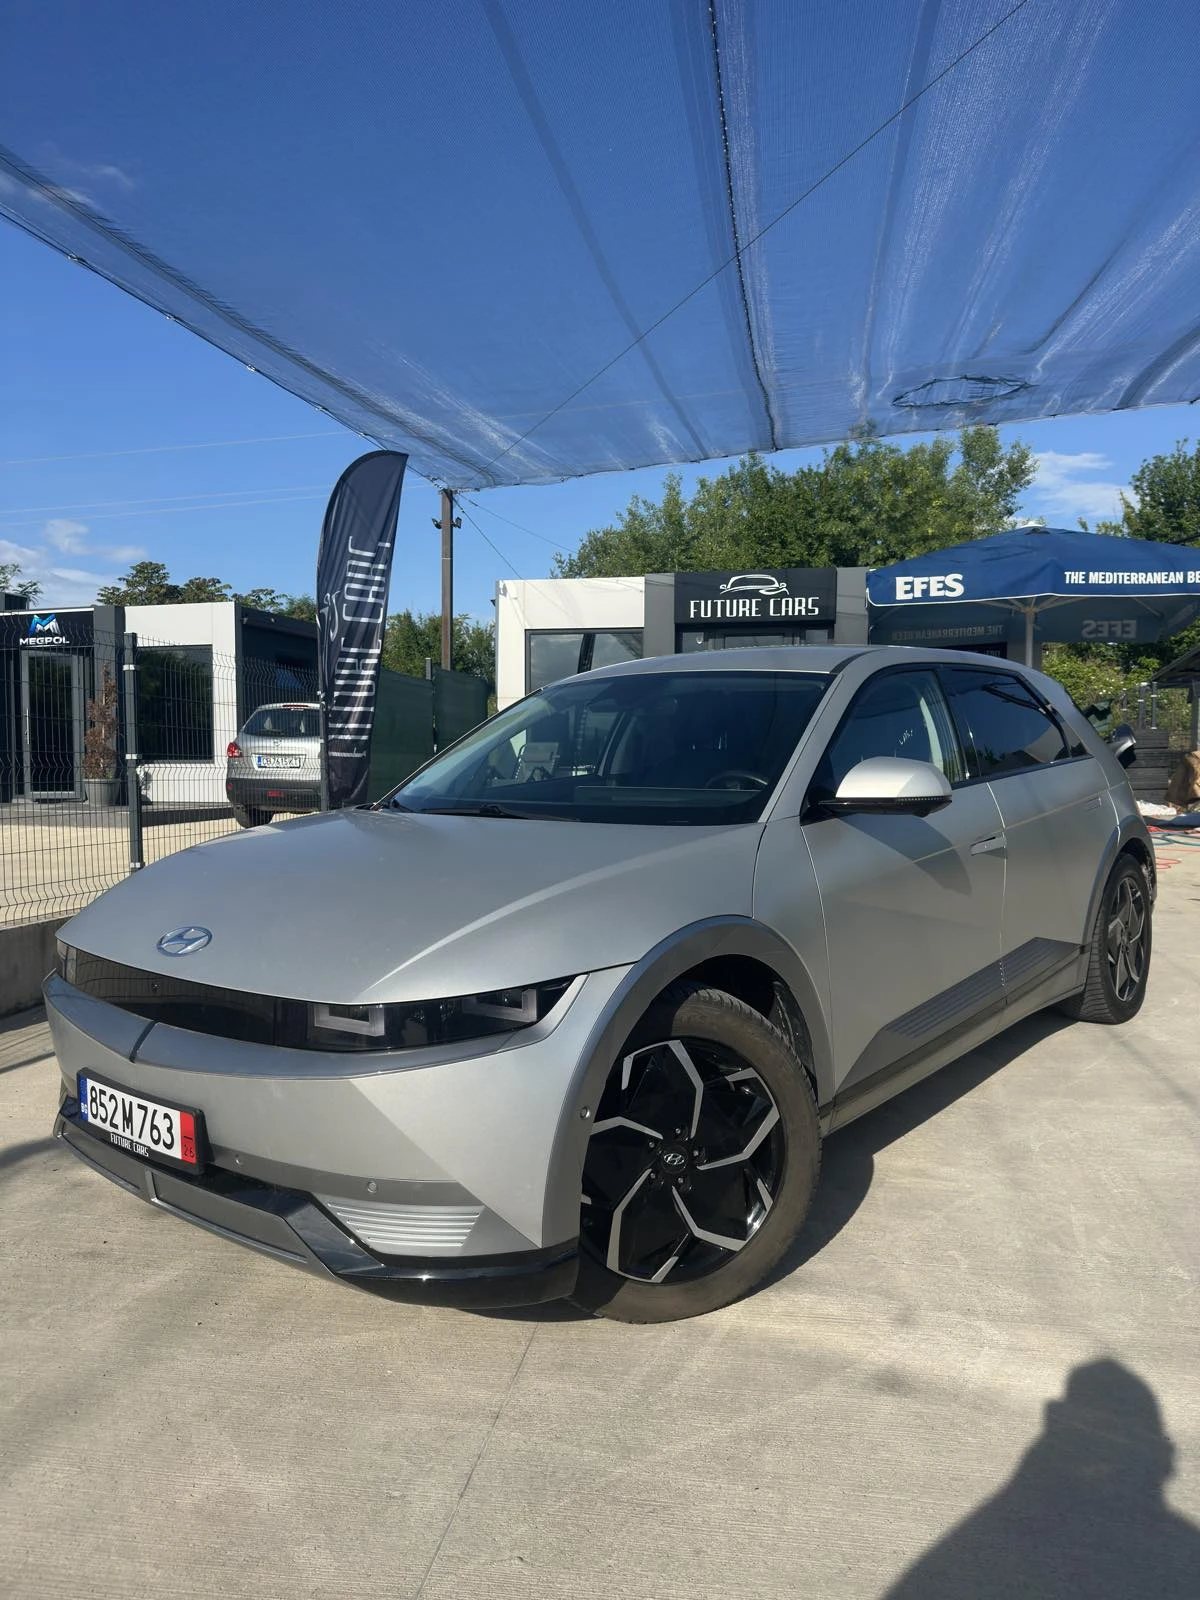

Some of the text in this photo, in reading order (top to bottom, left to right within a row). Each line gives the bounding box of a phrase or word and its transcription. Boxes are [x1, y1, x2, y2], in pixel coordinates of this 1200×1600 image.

[895, 574, 965, 600] EFES
[1064, 571, 1086, 584] THE
[1088, 571, 1184, 584] MEDITERRANEAN
[689, 596, 820, 619] FUTURE CARS
[19, 636, 70, 646] MEGPOL
[110, 1131, 149, 1158] FUTURE CARS
